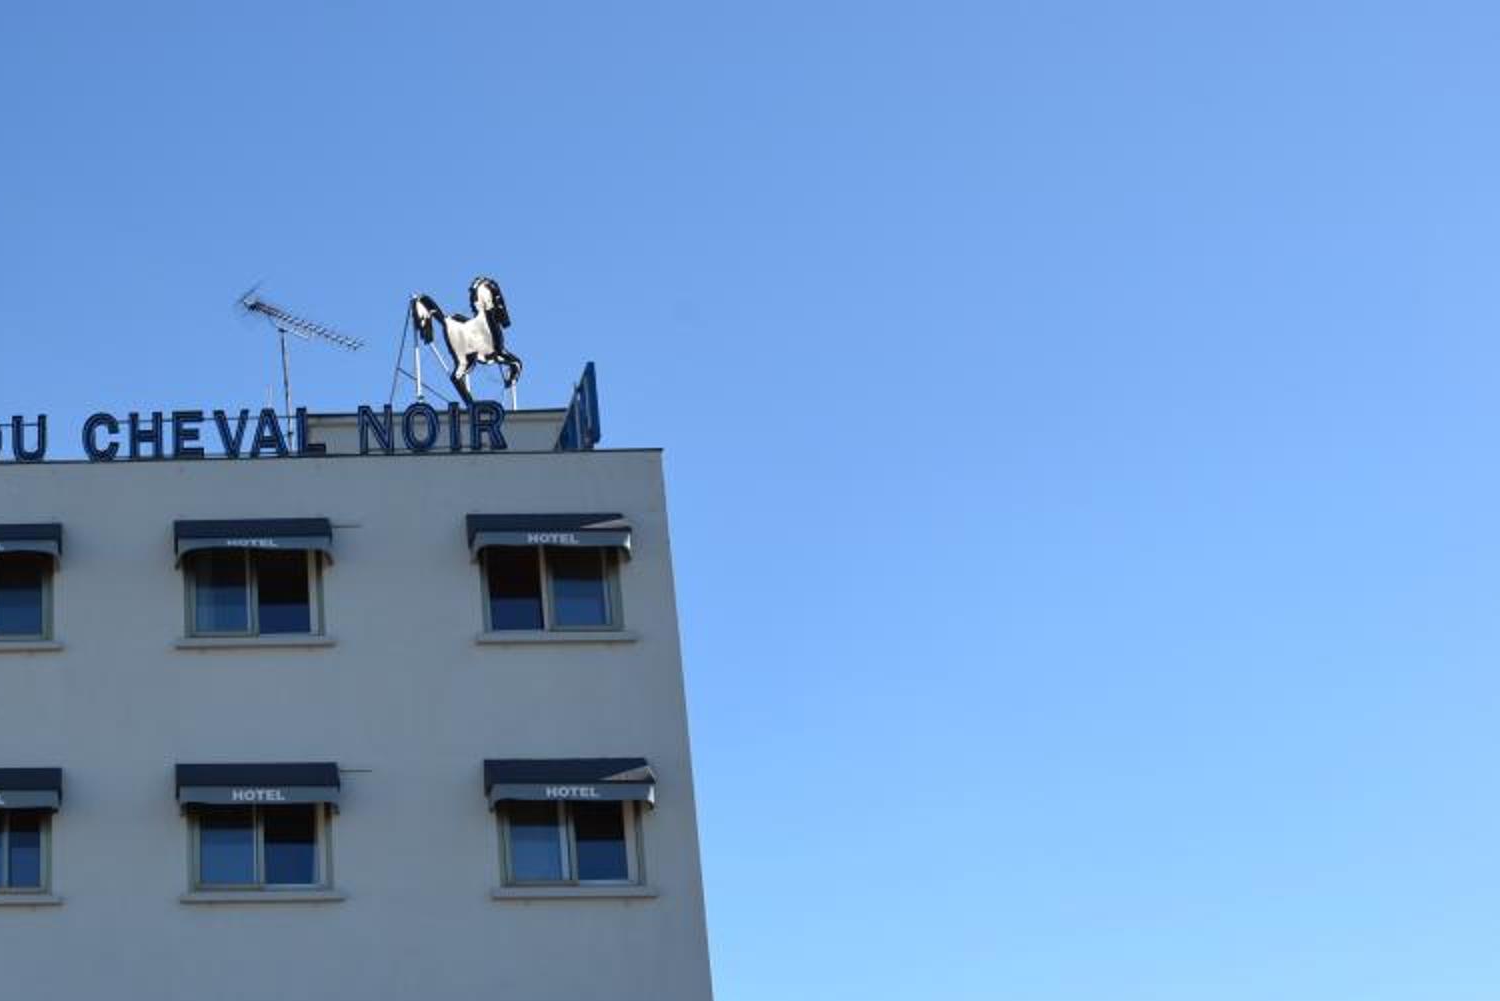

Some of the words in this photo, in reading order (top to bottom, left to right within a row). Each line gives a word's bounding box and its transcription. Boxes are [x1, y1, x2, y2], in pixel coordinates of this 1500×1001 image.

[82, 407, 327, 460] CHEVAL
[357, 400, 508, 456] NOIR
[227, 538, 278, 548] HOTEL
[528, 532, 580, 545] HOTEL
[232, 789, 286, 801] HOTEL
[546, 786, 600, 799] HOTEL
